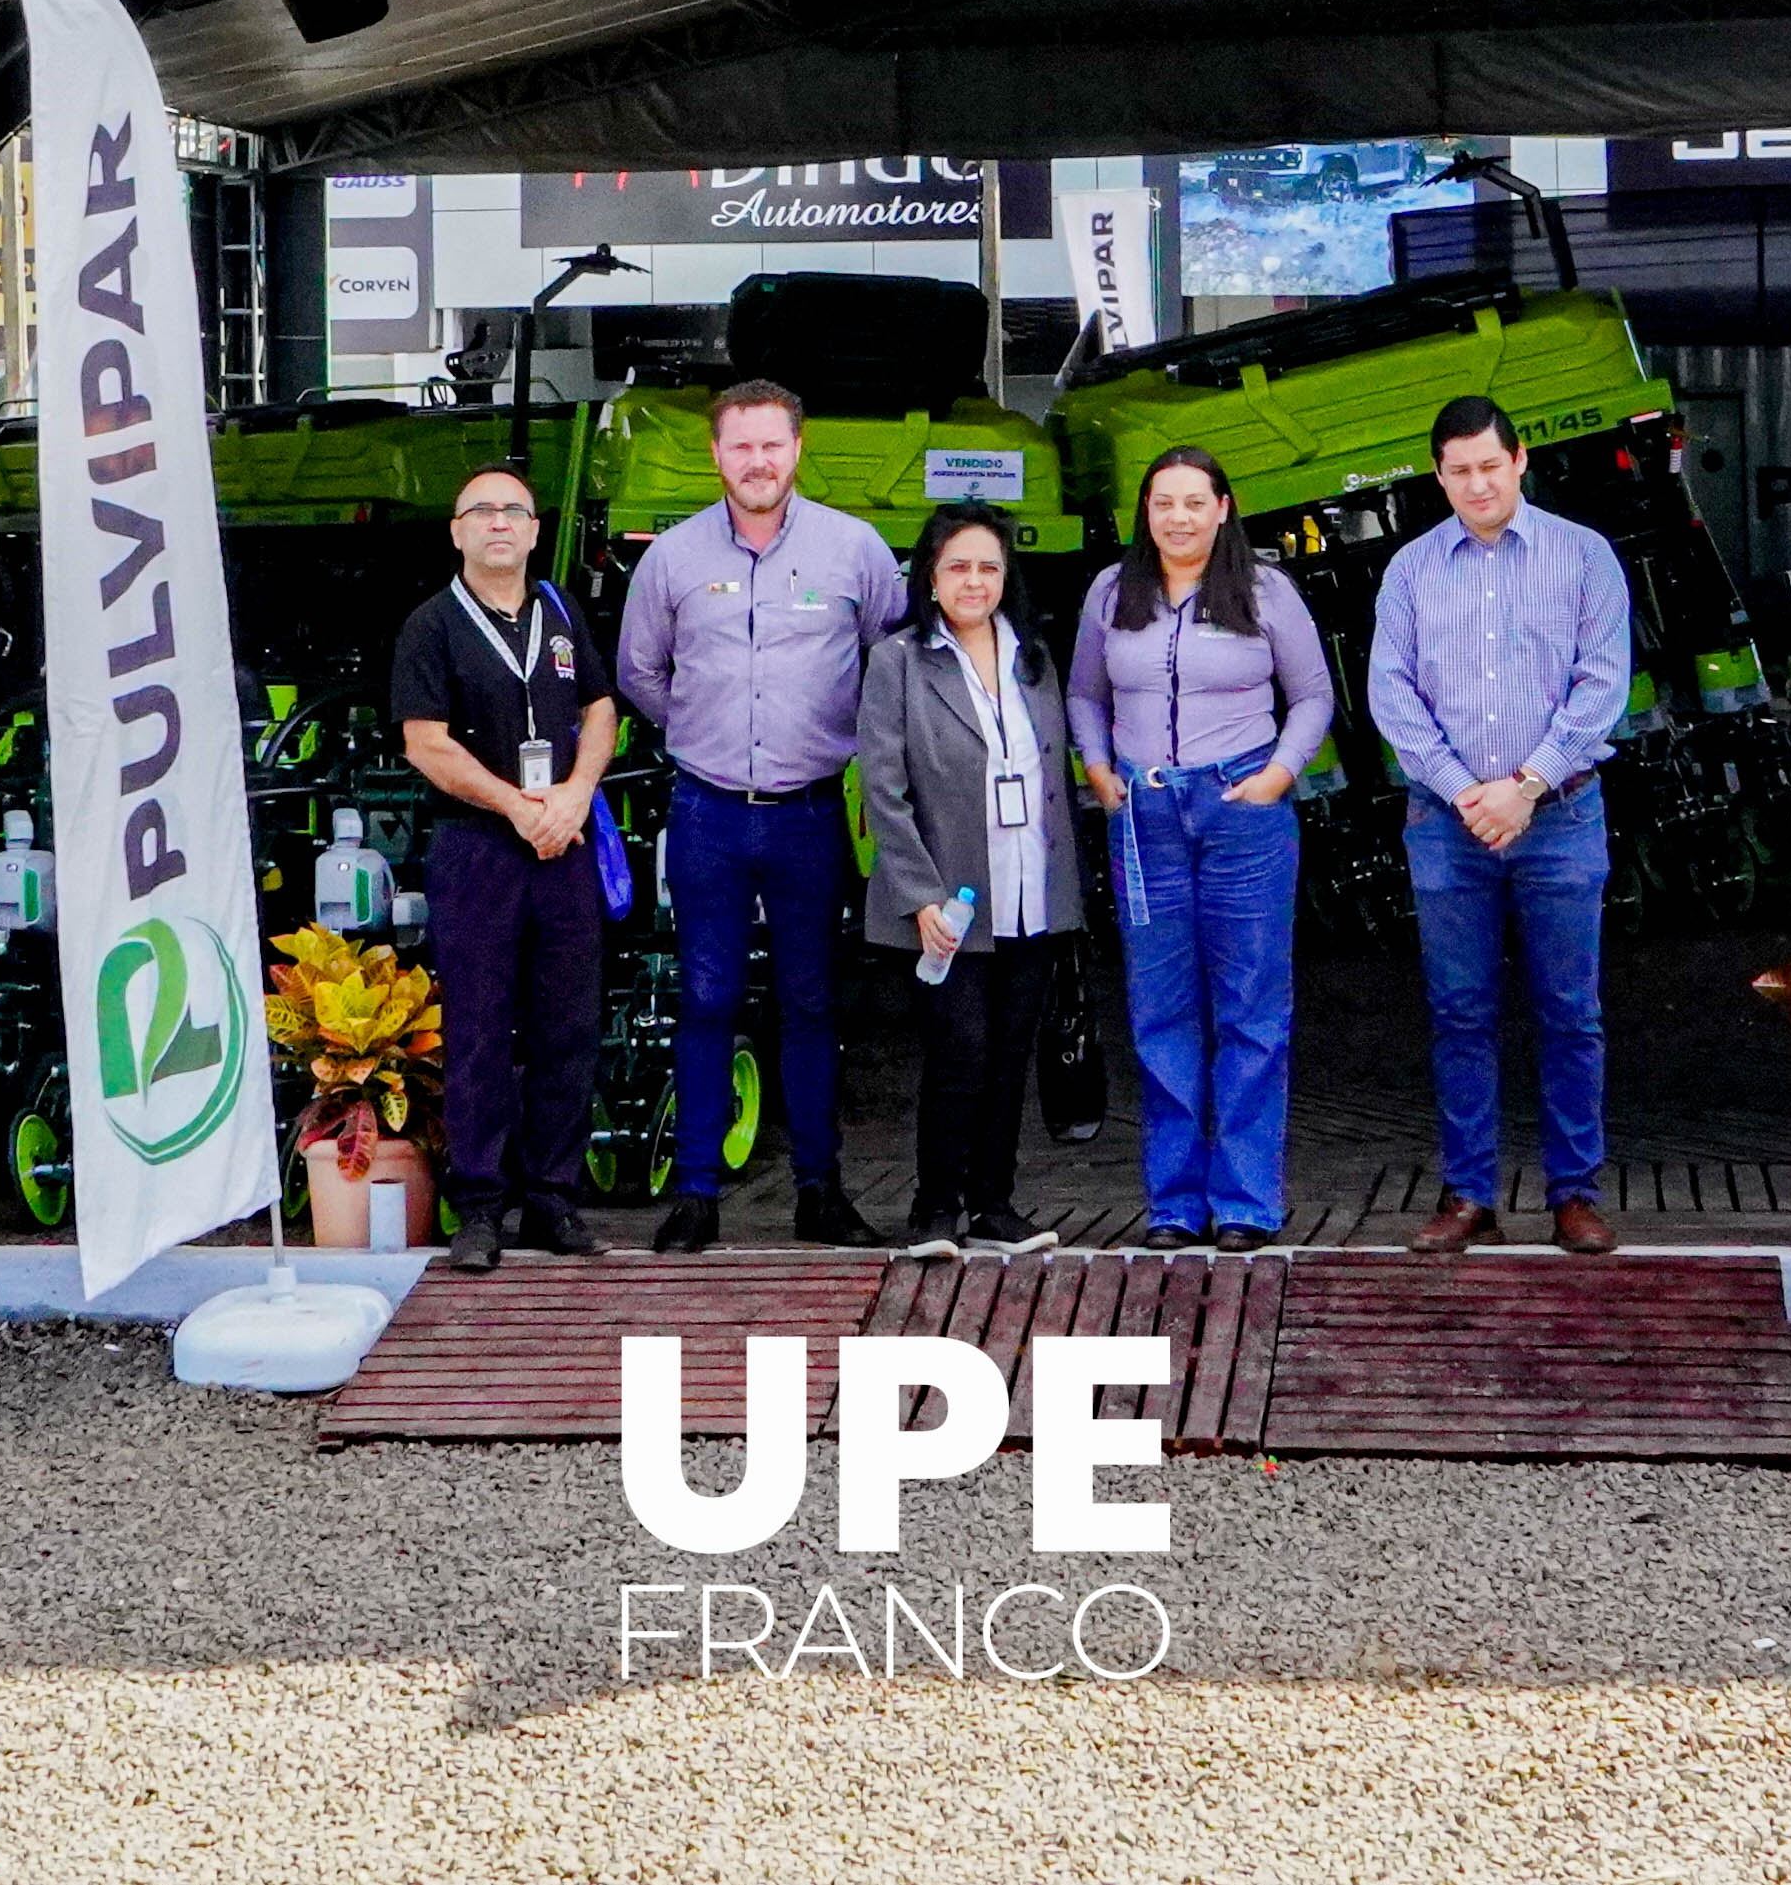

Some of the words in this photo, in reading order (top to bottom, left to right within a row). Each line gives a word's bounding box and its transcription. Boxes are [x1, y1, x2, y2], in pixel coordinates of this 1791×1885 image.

[710, 188, 982, 228] Automotores
[339, 277, 410, 294] CORVEN
[78, 110, 188, 903] PULVIPAR
